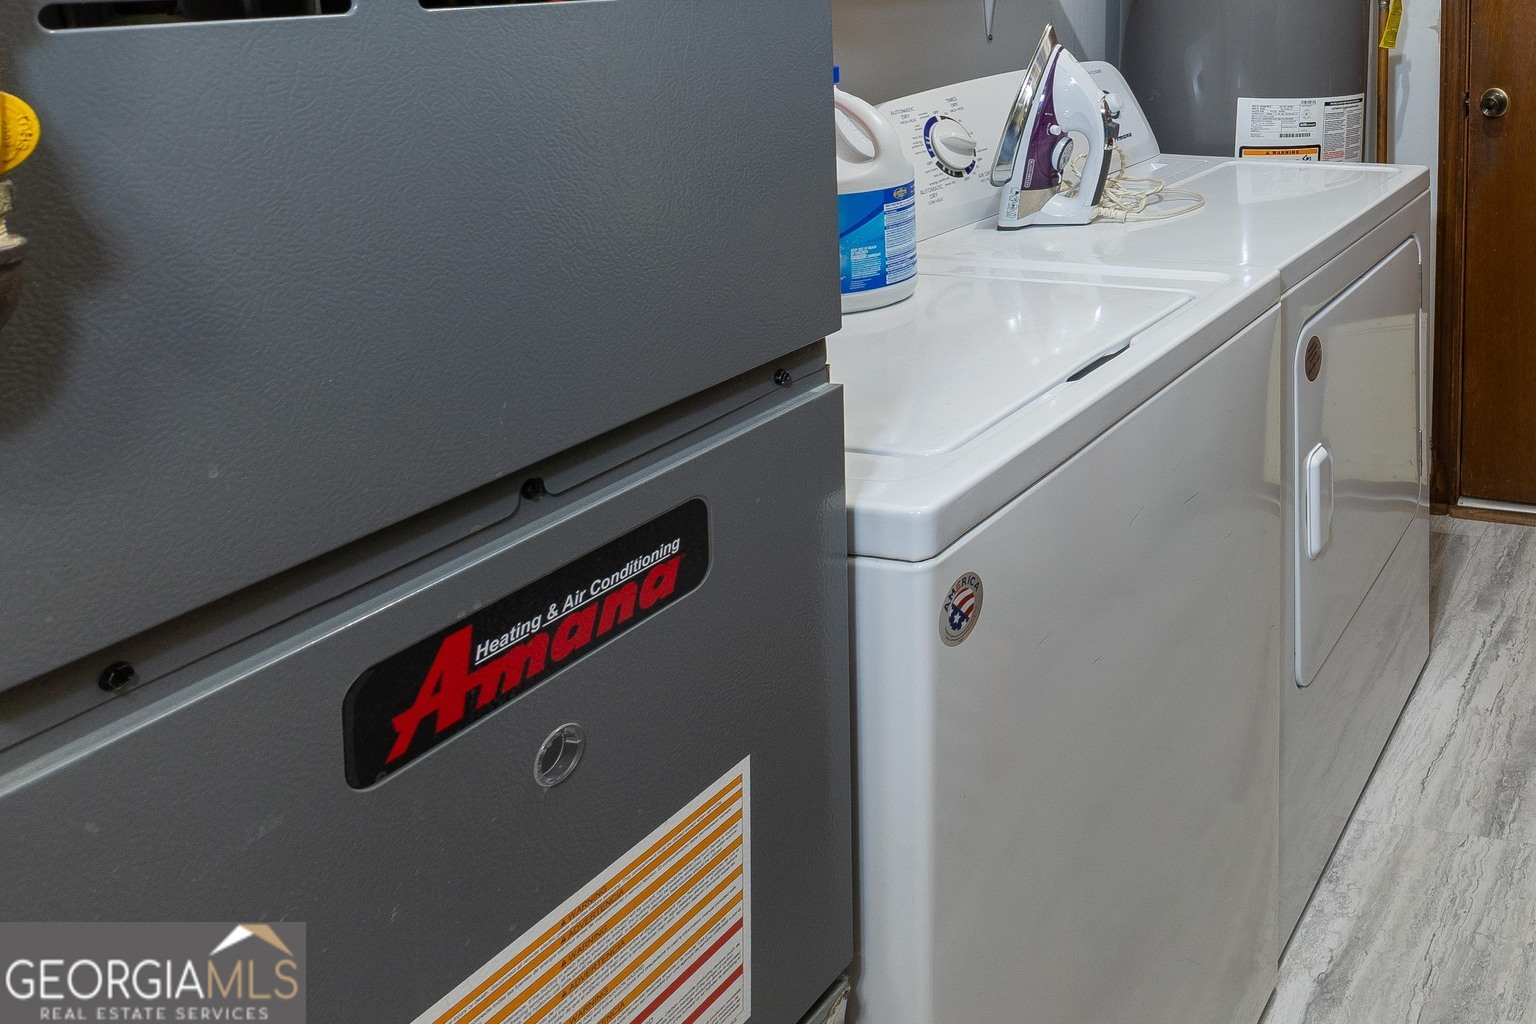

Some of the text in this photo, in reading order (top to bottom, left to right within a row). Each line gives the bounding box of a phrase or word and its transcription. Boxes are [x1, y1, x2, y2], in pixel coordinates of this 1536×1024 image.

[475, 537, 680, 662] Heating & Air Conditioning
[944, 576, 980, 612] AMERICA
[386, 556, 684, 764] Amana
[567, 885, 608, 922] WARNING
[568, 889, 624, 938] ADVERTENCIA
[568, 925, 608, 962] WARNING
[569, 939, 626, 990] ADVERTENCIA
